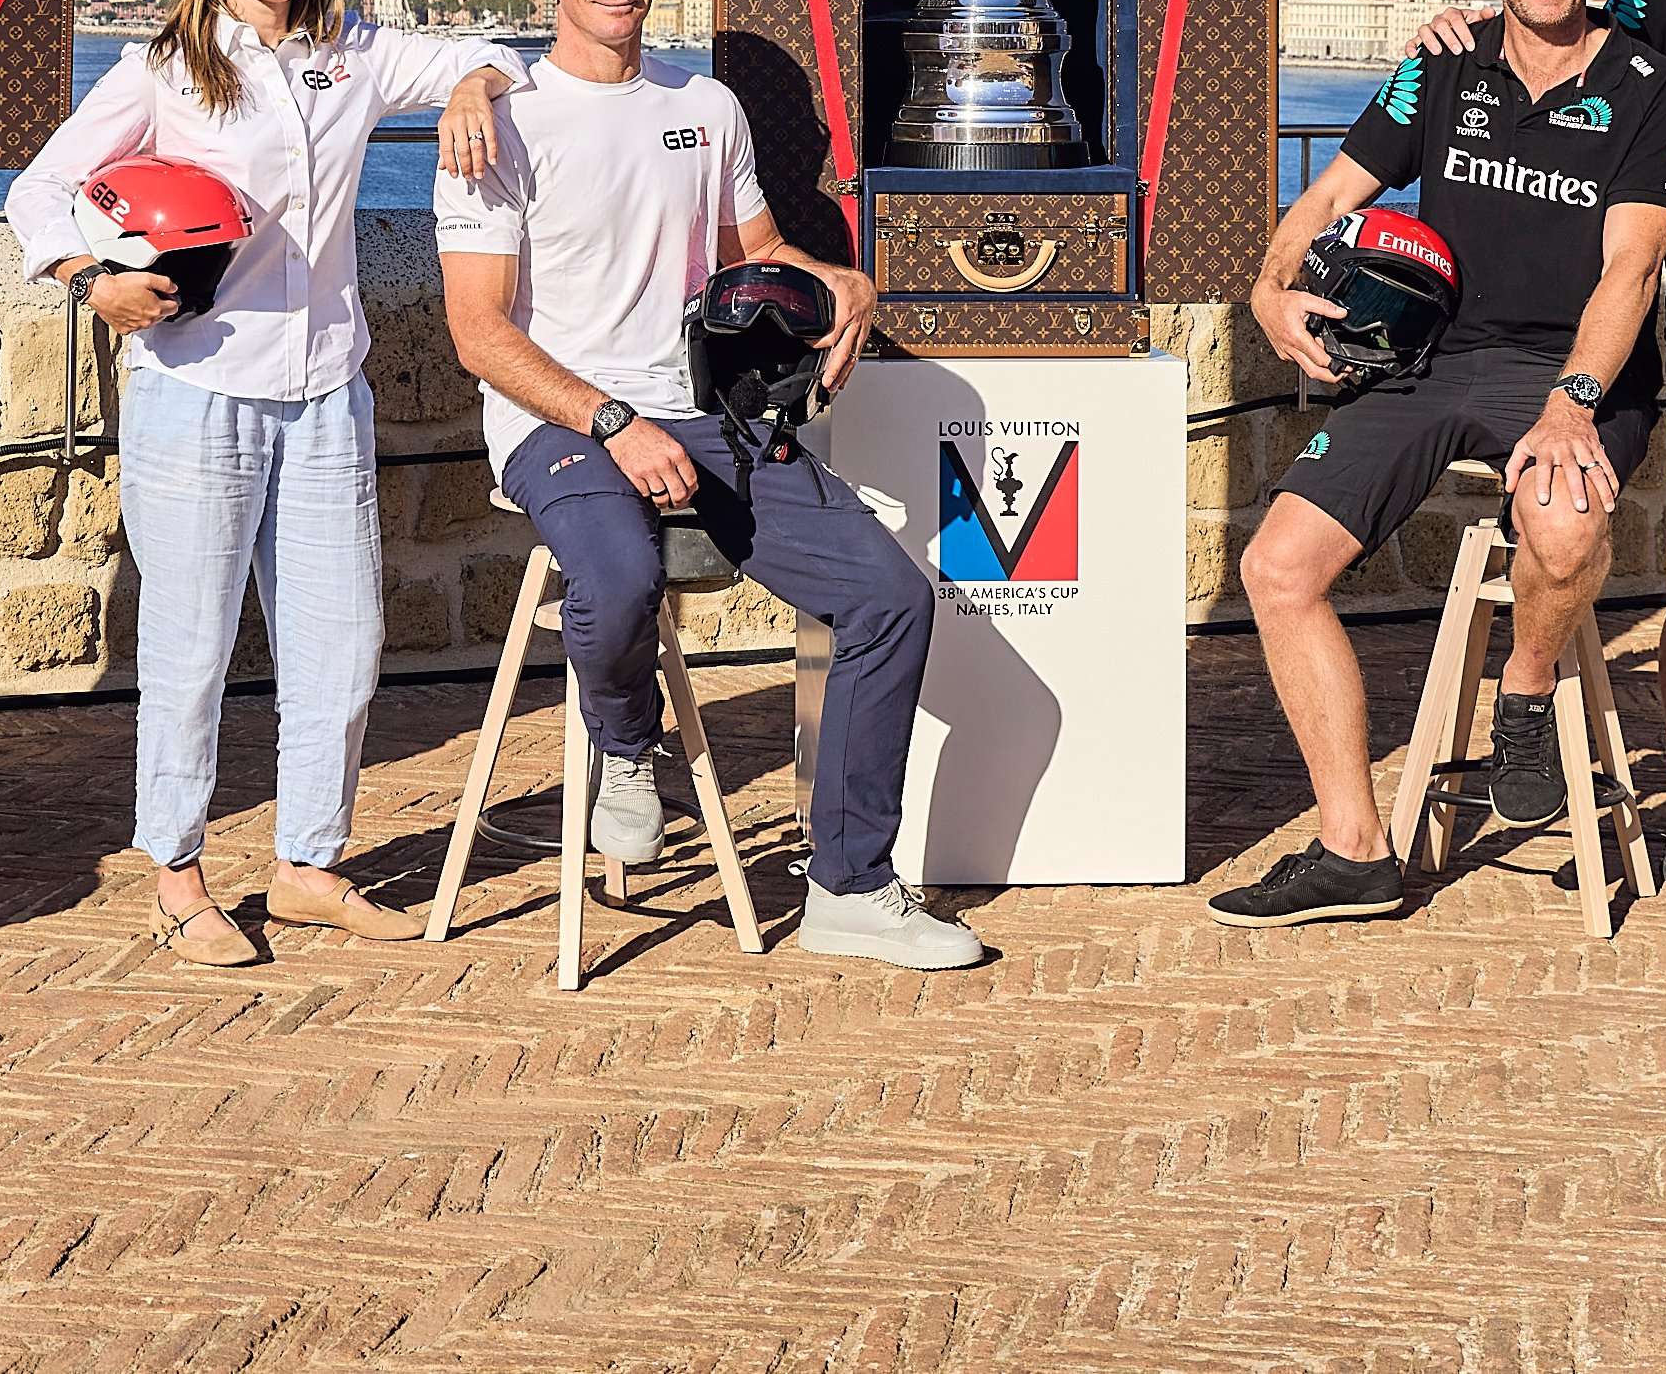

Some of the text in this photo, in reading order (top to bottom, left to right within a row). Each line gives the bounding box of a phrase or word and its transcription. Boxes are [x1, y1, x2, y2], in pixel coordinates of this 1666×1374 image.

[301, 65, 351, 91] GB2
[1460, 90, 1501, 107] OMEGA
[662, 126, 711, 151] GB1
[1455, 125, 1491, 140] TOYOTA
[1443, 146, 1598, 208] Emirates
[91, 181, 131, 224] GB2
[1377, 230, 1453, 277] Emirates
[938, 421, 1080, 437] LOUIS VUITTON
[938, 587, 1079, 599] 38TH AMERICA'S CUP
[956, 603, 1054, 617] NAPLES, ITALY
